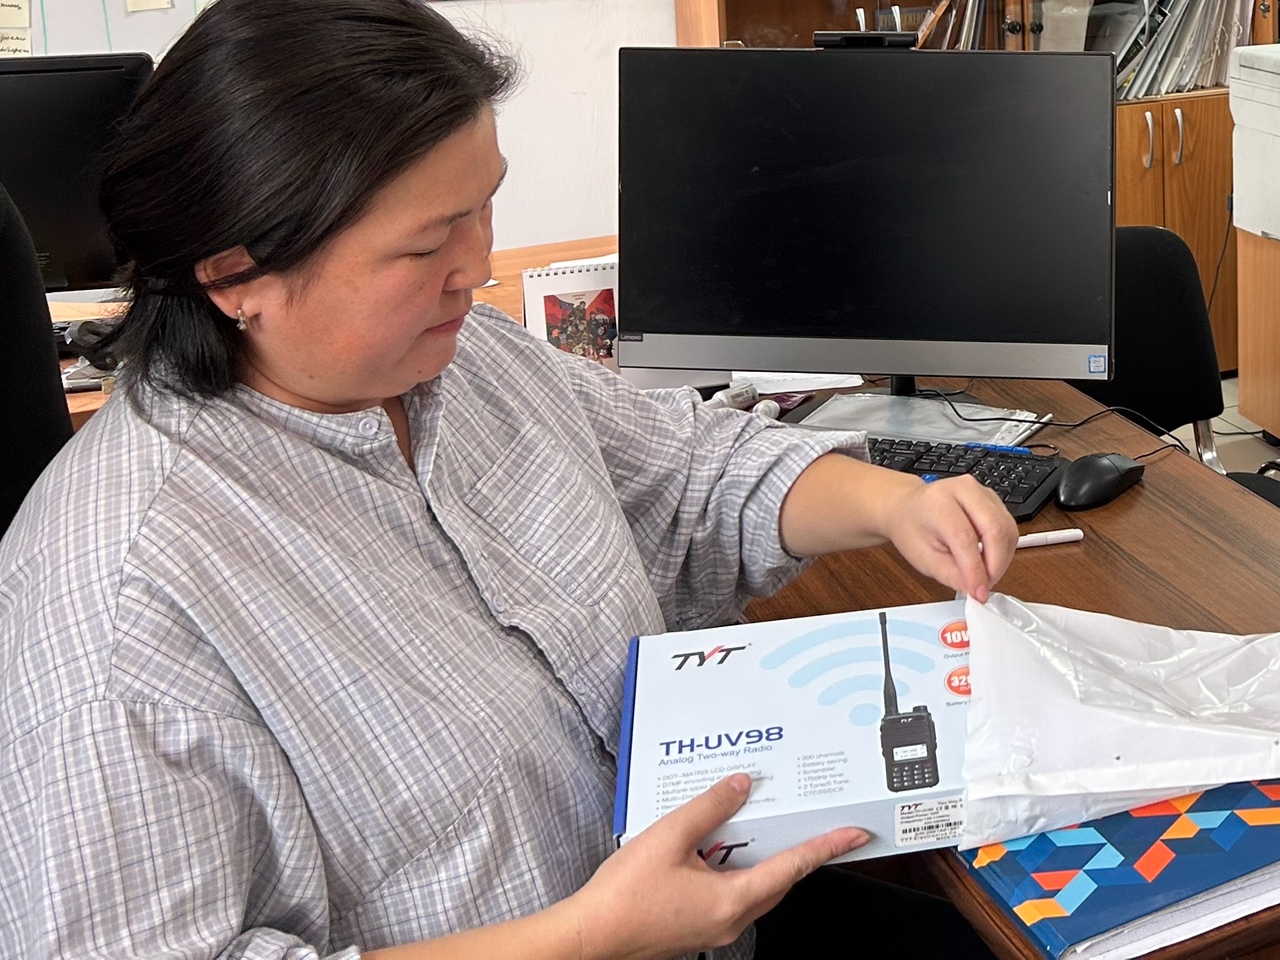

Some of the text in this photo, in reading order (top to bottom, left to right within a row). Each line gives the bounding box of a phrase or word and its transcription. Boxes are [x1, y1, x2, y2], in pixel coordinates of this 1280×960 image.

[671, 644, 747, 671] TYT
[659, 726, 784, 757] TH-UV98
[658, 744, 773, 767] Analog Two-way Radio
[697, 841, 750, 865] YT
